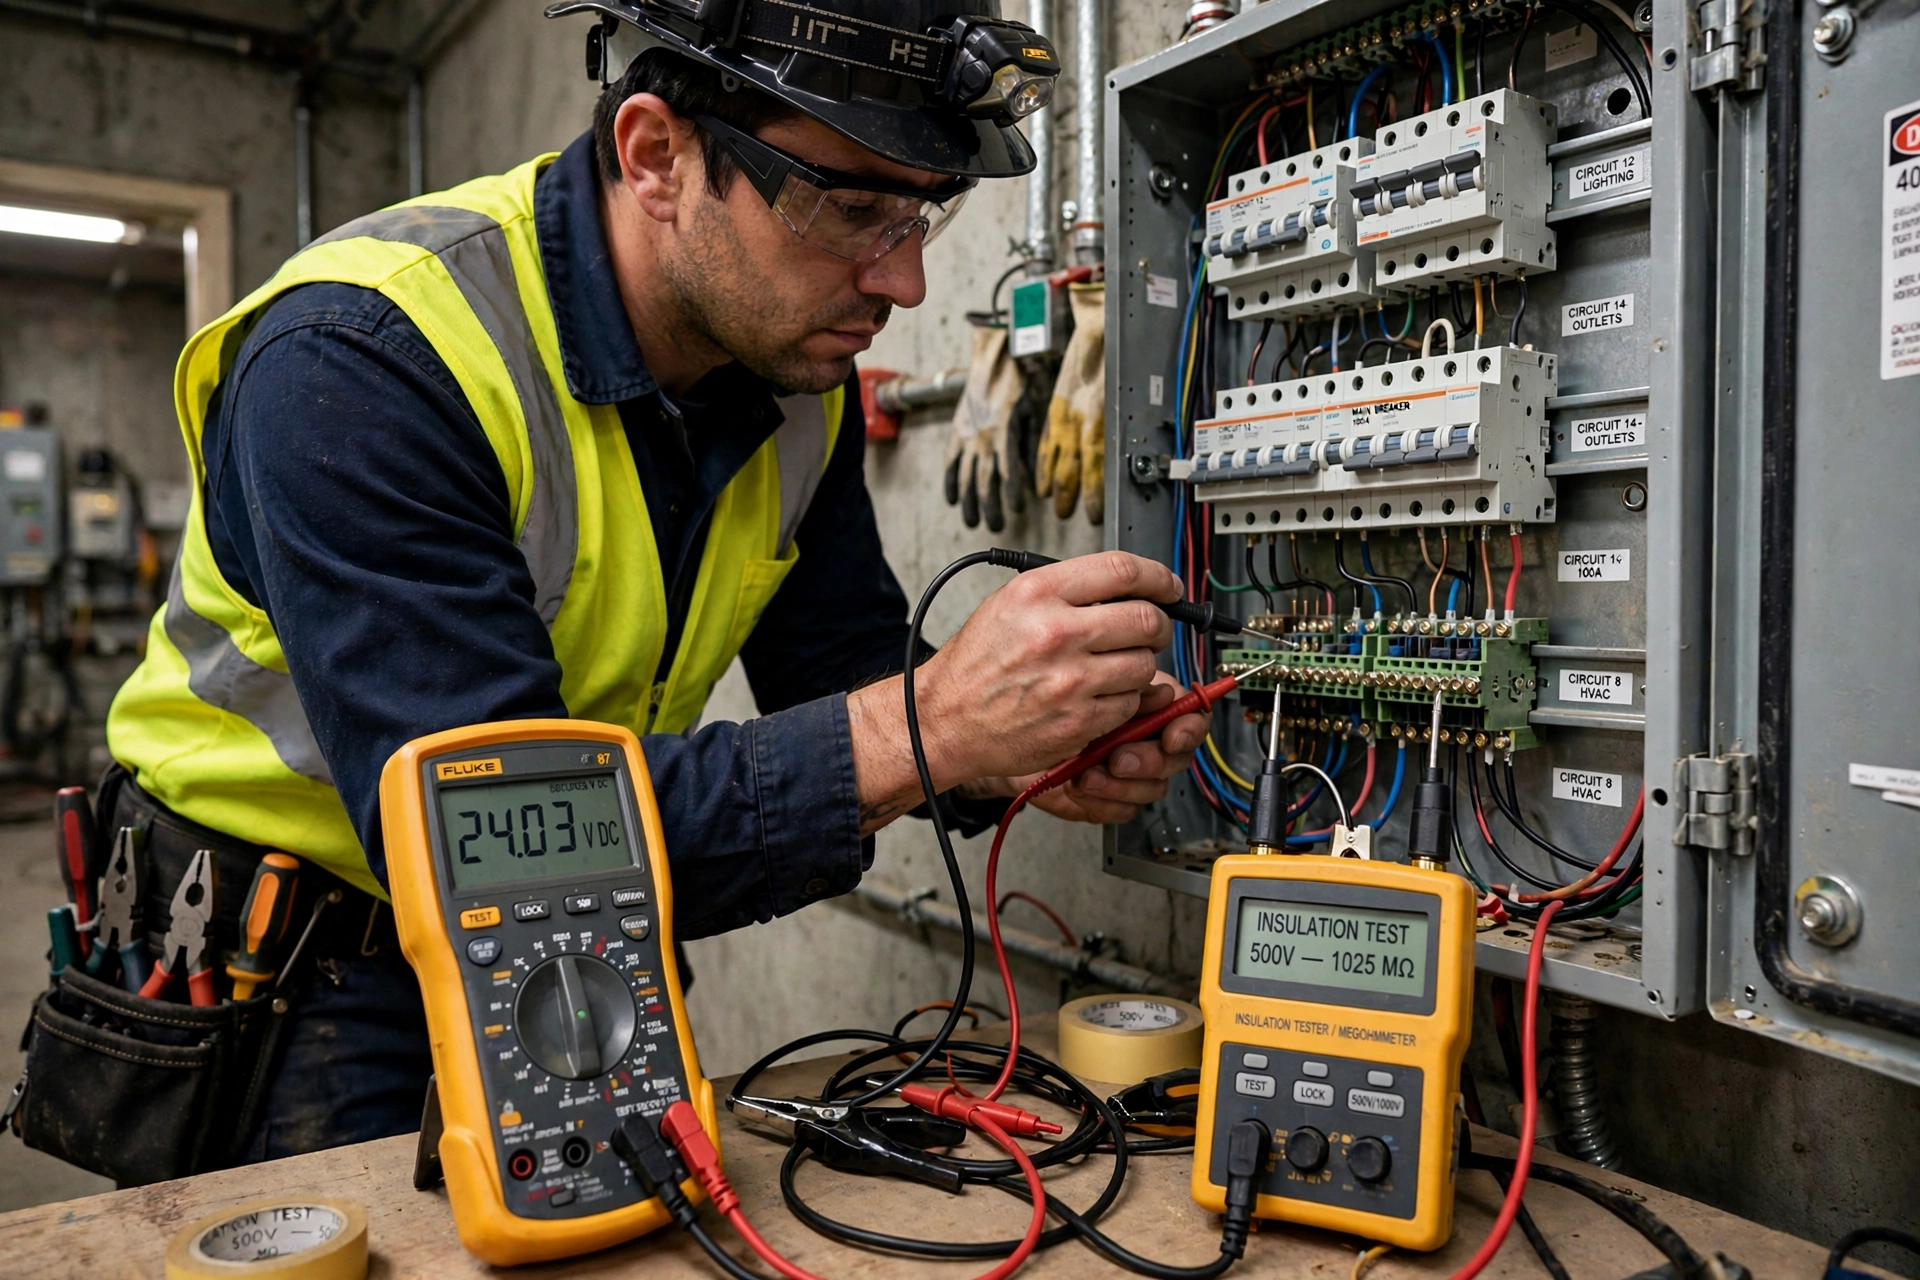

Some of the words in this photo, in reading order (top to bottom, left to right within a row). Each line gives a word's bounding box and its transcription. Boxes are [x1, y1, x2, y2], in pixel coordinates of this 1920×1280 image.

[1576, 160, 1619, 180] CIRCUIT
[1623, 156, 1635, 168] 12
[1583, 170, 1634, 192] LIGHTING
[1568, 302, 1610, 318] CIRCUIT
[1572, 313, 1622, 331] OUTLETS
[1577, 419, 1621, 433] CIRCUIT
[1585, 432, 1635, 447] OUTLETS
[1564, 554, 1607, 565] CIRCUIT
[1578, 567, 1602, 578] 100A
[1568, 673, 1611, 687] CIRCUIT
[1615, 676, 1621, 687] 8
[1580, 687, 1611, 700] HVAC
[597, 752, 610, 765] 87
[443, 763, 496, 776] FLUKE
[1560, 772, 1602, 787] CIRCUIT
[1605, 778, 1612, 789] 8
[1571, 788, 1602, 801] HVAC
[458, 801, 577, 864] 24.03
[582, 822, 593, 848] V
[598, 820, 620, 847] DC
[469, 911, 493, 923] TEST
[521, 904, 544, 917] LOCK
[1257, 911, 1358, 940] INSULATION
[1365, 921, 1410, 945] TEST
[1250, 943, 1295, 966] 500V
[1332, 951, 1376, 975] 1025
[1382, 955, 1414, 978] MΩ
[1235, 1012, 1290, 1031] INSULATION
[1294, 1020, 1329, 1036] TESTER
[1339, 1026, 1416, 1047] MEGOHMMETER
[1244, 1079, 1267, 1091] TEST
[1301, 1087, 1325, 1100] LOCK
[1351, 1094, 1401, 1111] 500V/1000V
[271, 1207, 313, 1222] TEST
[232, 1228, 277, 1250] 500V
